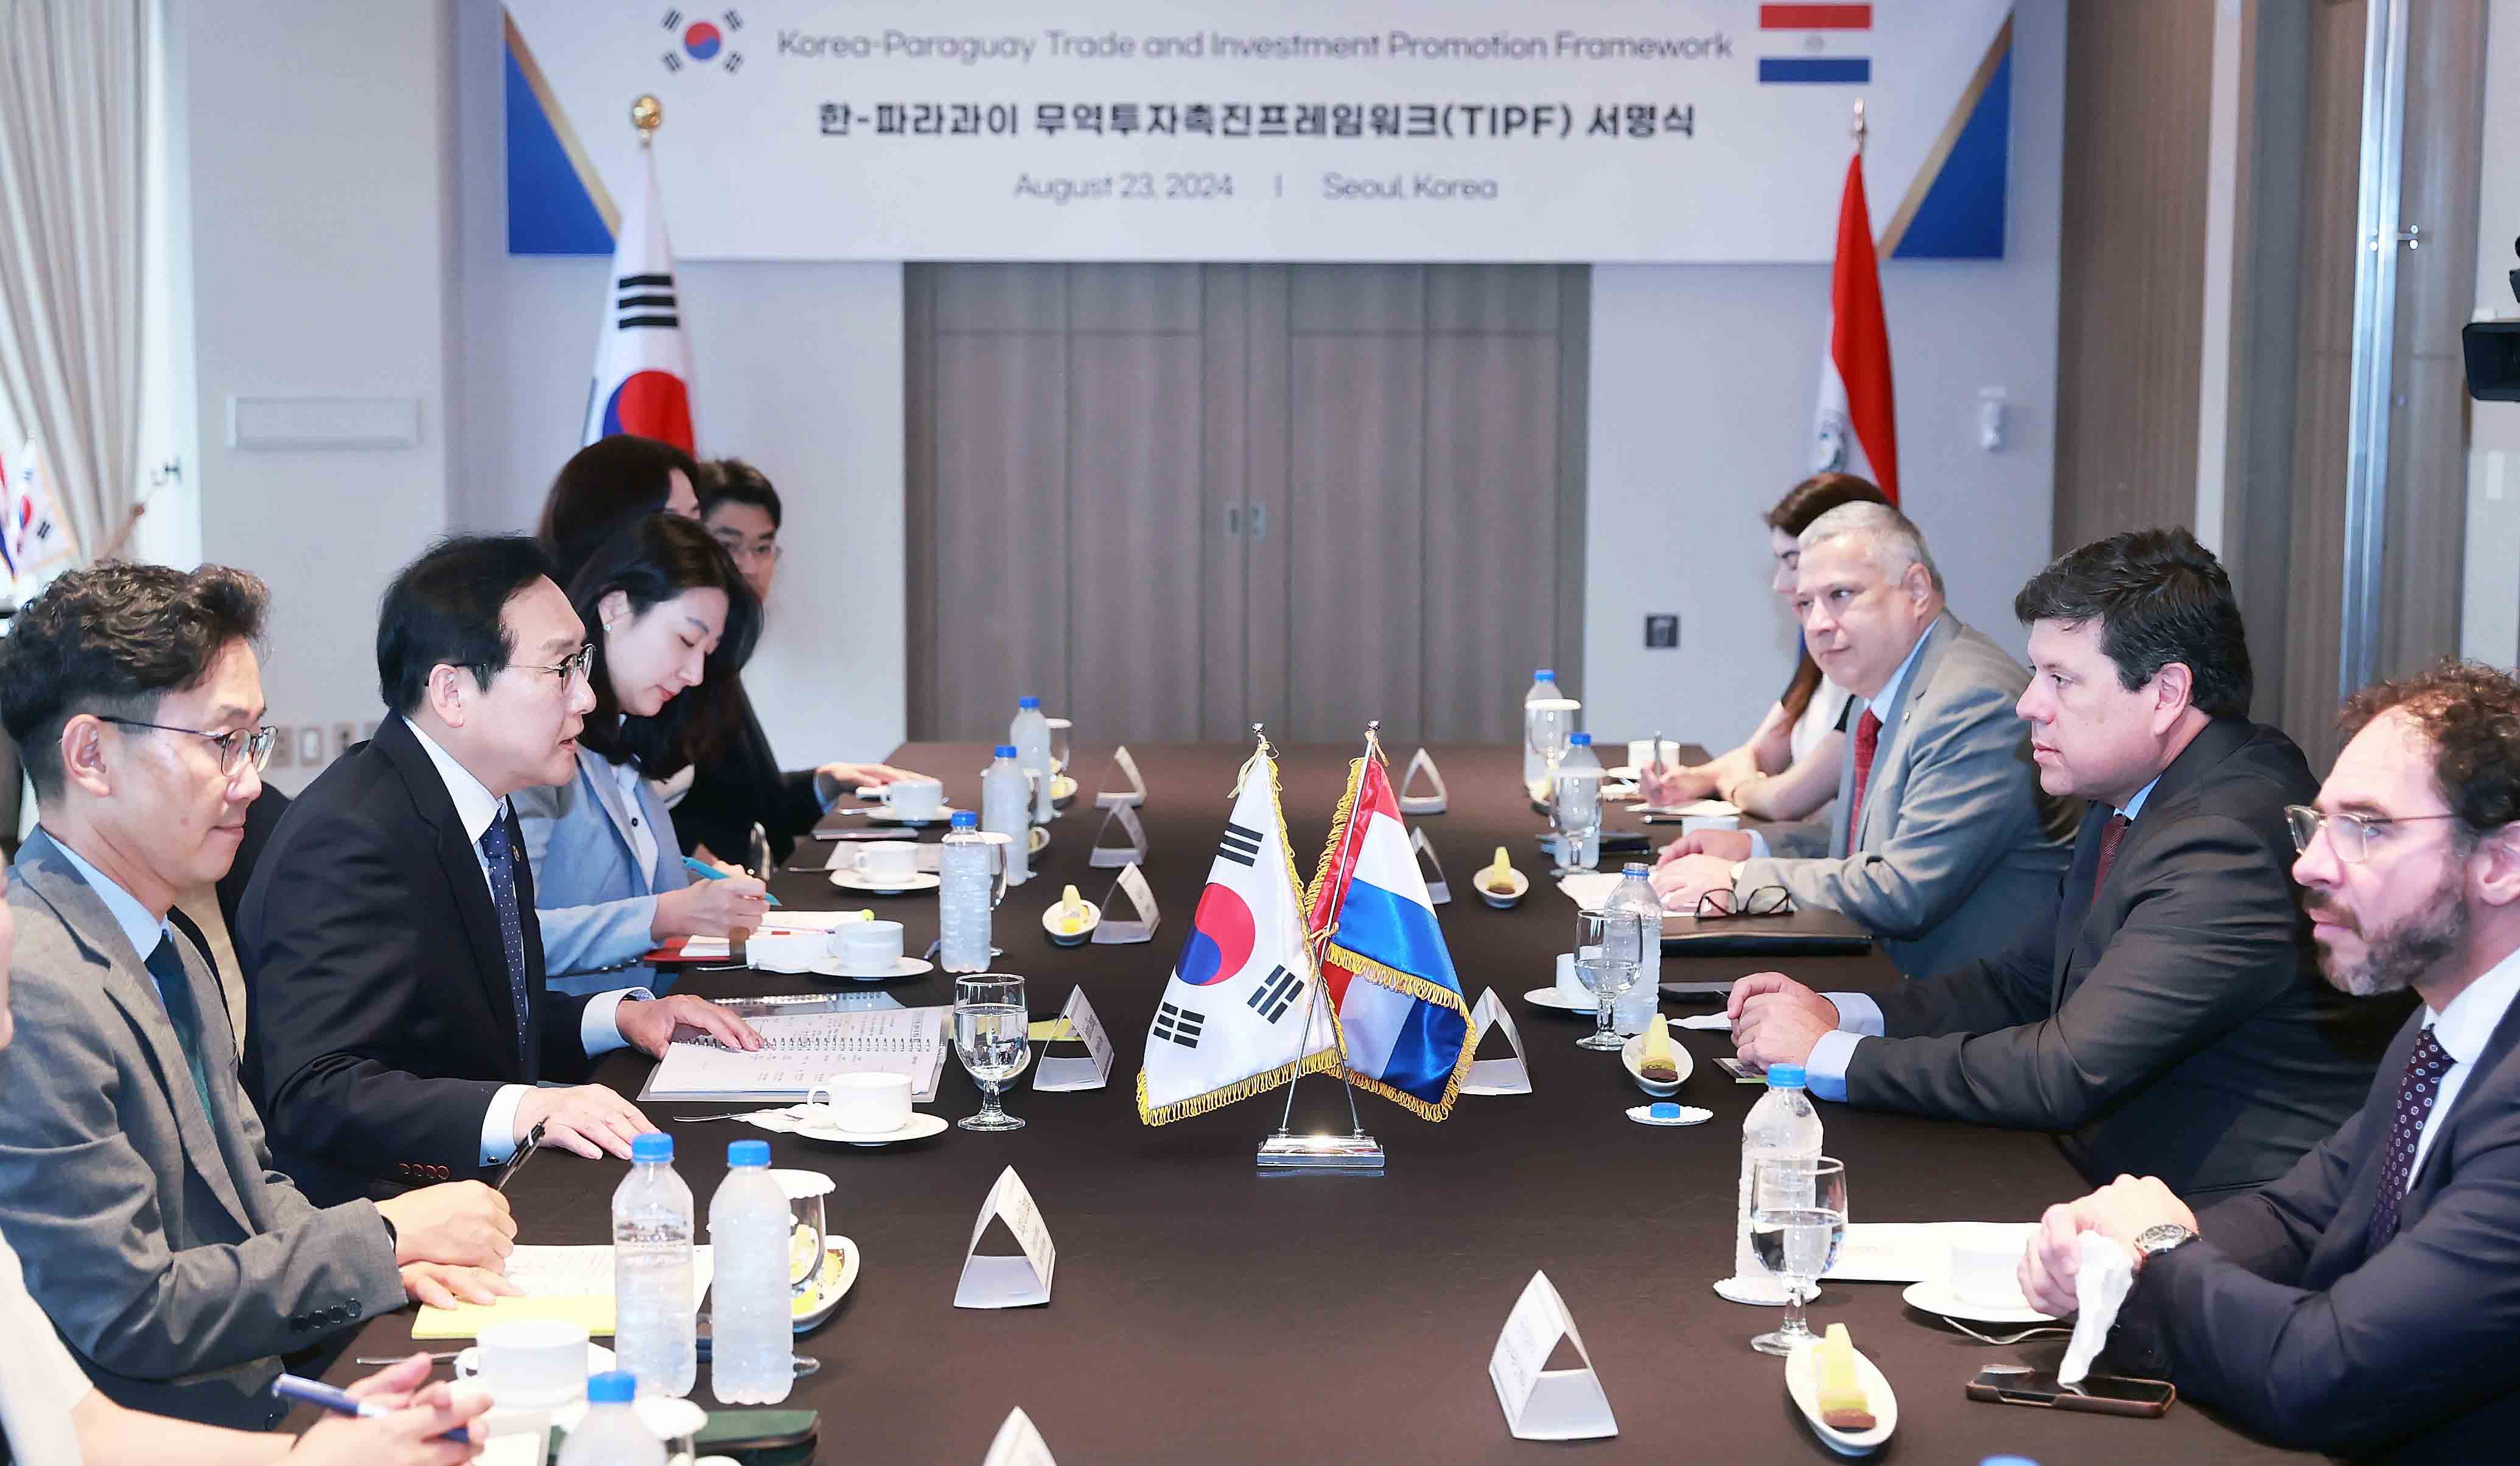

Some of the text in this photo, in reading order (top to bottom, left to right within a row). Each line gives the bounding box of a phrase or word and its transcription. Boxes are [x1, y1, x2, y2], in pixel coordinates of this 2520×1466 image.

[778, 29, 1734, 65] Korea-Paraguay Trade and Investment Promotion Framework
[819, 102, 1695, 139] 한-파라과이 무역투자촉진프레임워크(TIPF) 서명식
[1014, 173, 1113, 205] August
[1120, 173, 1156, 200] 23,
[1166, 173, 1233, 200] 2024
[1323, 172, 1404, 201] Seoul,
[1413, 173, 1498, 201] Korea
